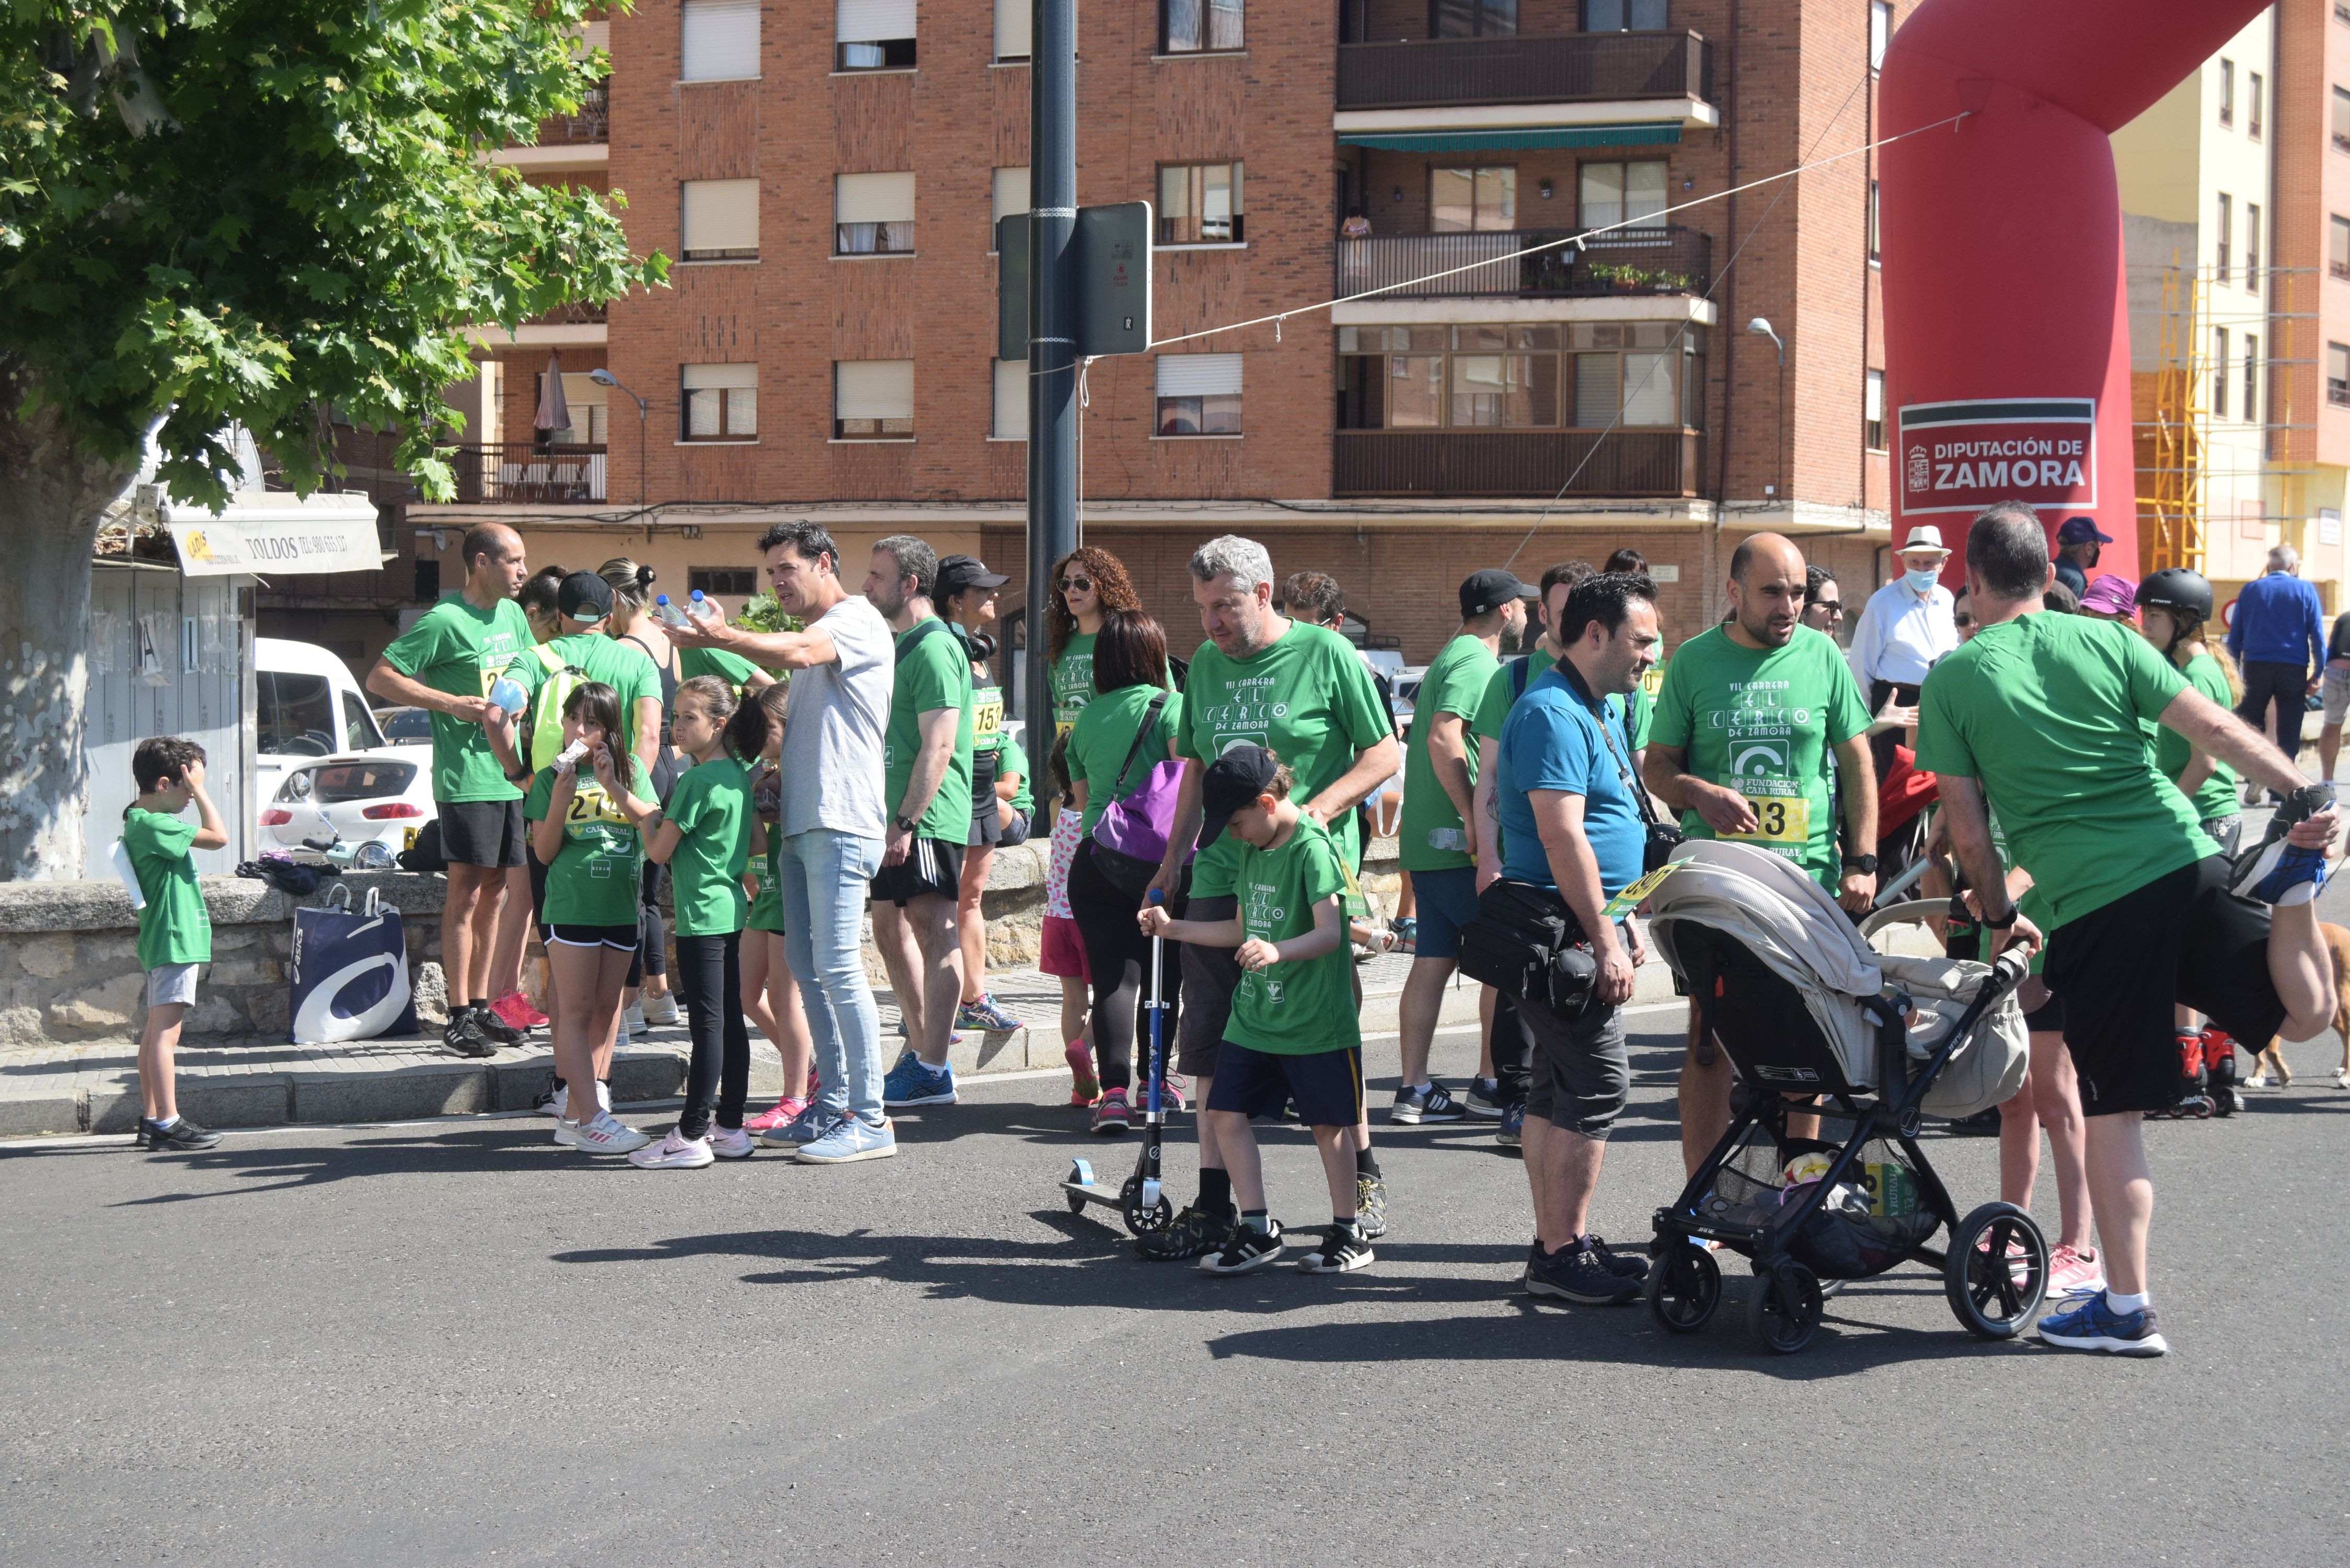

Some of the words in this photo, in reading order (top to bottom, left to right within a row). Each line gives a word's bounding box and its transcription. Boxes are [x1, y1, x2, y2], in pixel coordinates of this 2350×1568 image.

[1935, 437, 2052, 459] DIPUTACIÓN
[2058, 440, 2083, 455] DE
[1935, 460, 2086, 490] ZAMORA
[188, 531, 207, 558] LADIS
[245, 537, 298, 559] TOLDOS
[312, 536, 326, 553] 980
[1226, 681, 1235, 690] VII
[1238, 677, 1275, 687] CARRERA
[1747, 681, 1789, 690] CARRERA
[1233, 688, 1259, 703] EL
[1745, 692, 1775, 707] EL
[978, 706, 1000, 731] 153
[1207, 704, 1287, 721] CERCO
[1713, 709, 1808, 727] CERCO
[1231, 720, 1269, 730] ZAMORA
[1729, 728, 1742, 737] DE
[1748, 727, 1791, 736] ZAMORA
[1746, 779, 1798, 789] FUNDACION
[1770, 788, 1798, 796] RURAL
[571, 792, 621, 820] 274
[607, 825, 629, 835] RURAL
[1255, 883, 1276, 893] CARRERA
[1249, 919, 1271, 928] ZAMORA
[295, 927, 303, 966] asics
